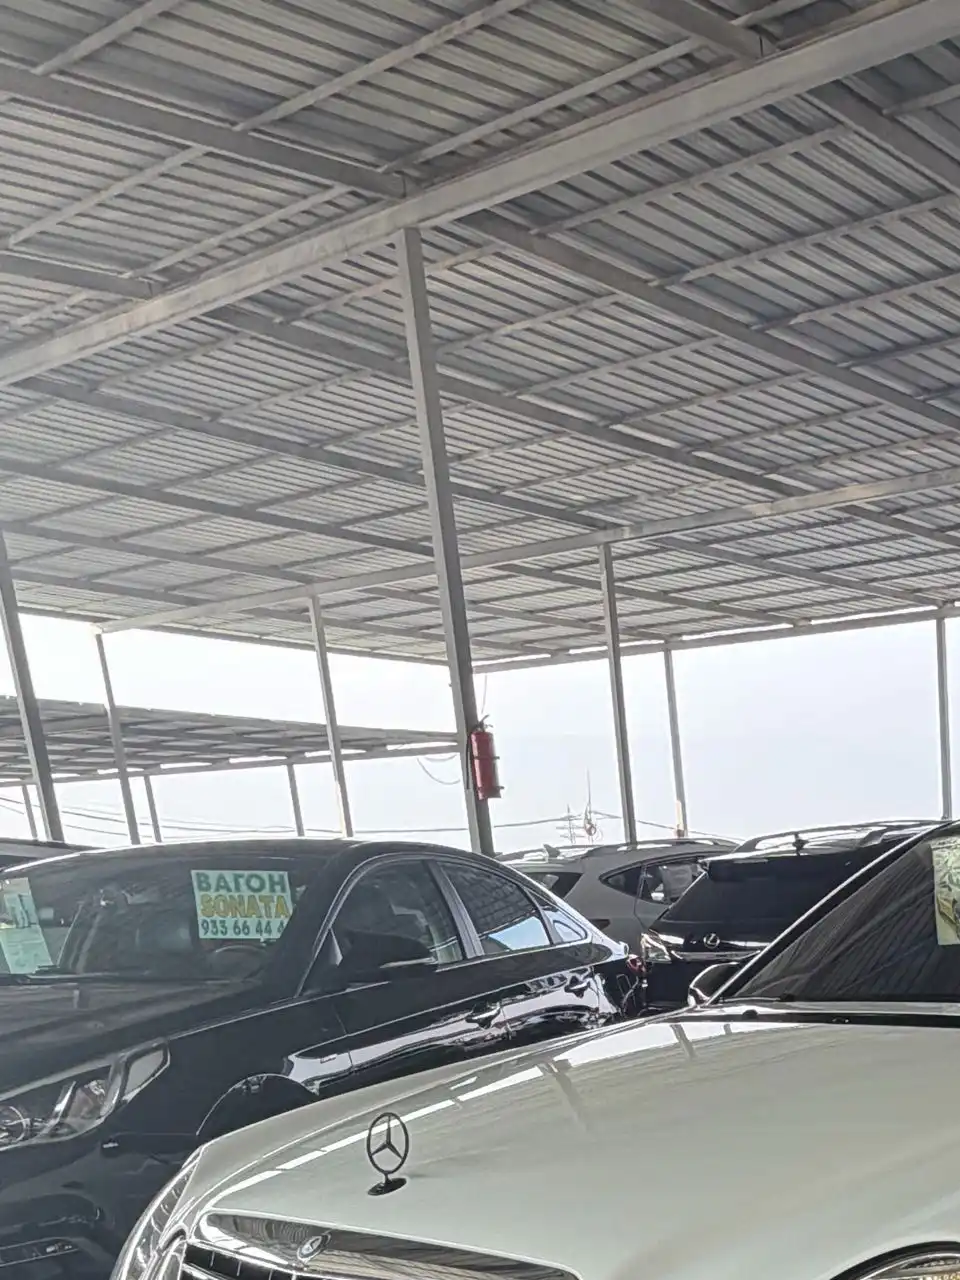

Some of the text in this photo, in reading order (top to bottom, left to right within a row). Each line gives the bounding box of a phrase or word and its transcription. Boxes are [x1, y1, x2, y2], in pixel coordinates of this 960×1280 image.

[195, 872, 287, 893] ВАГОН
[200, 894, 290, 918] SONATA
[201, 919, 228, 936] 933
[233, 920, 250, 936] 66
[255, 920, 273, 936] 44
